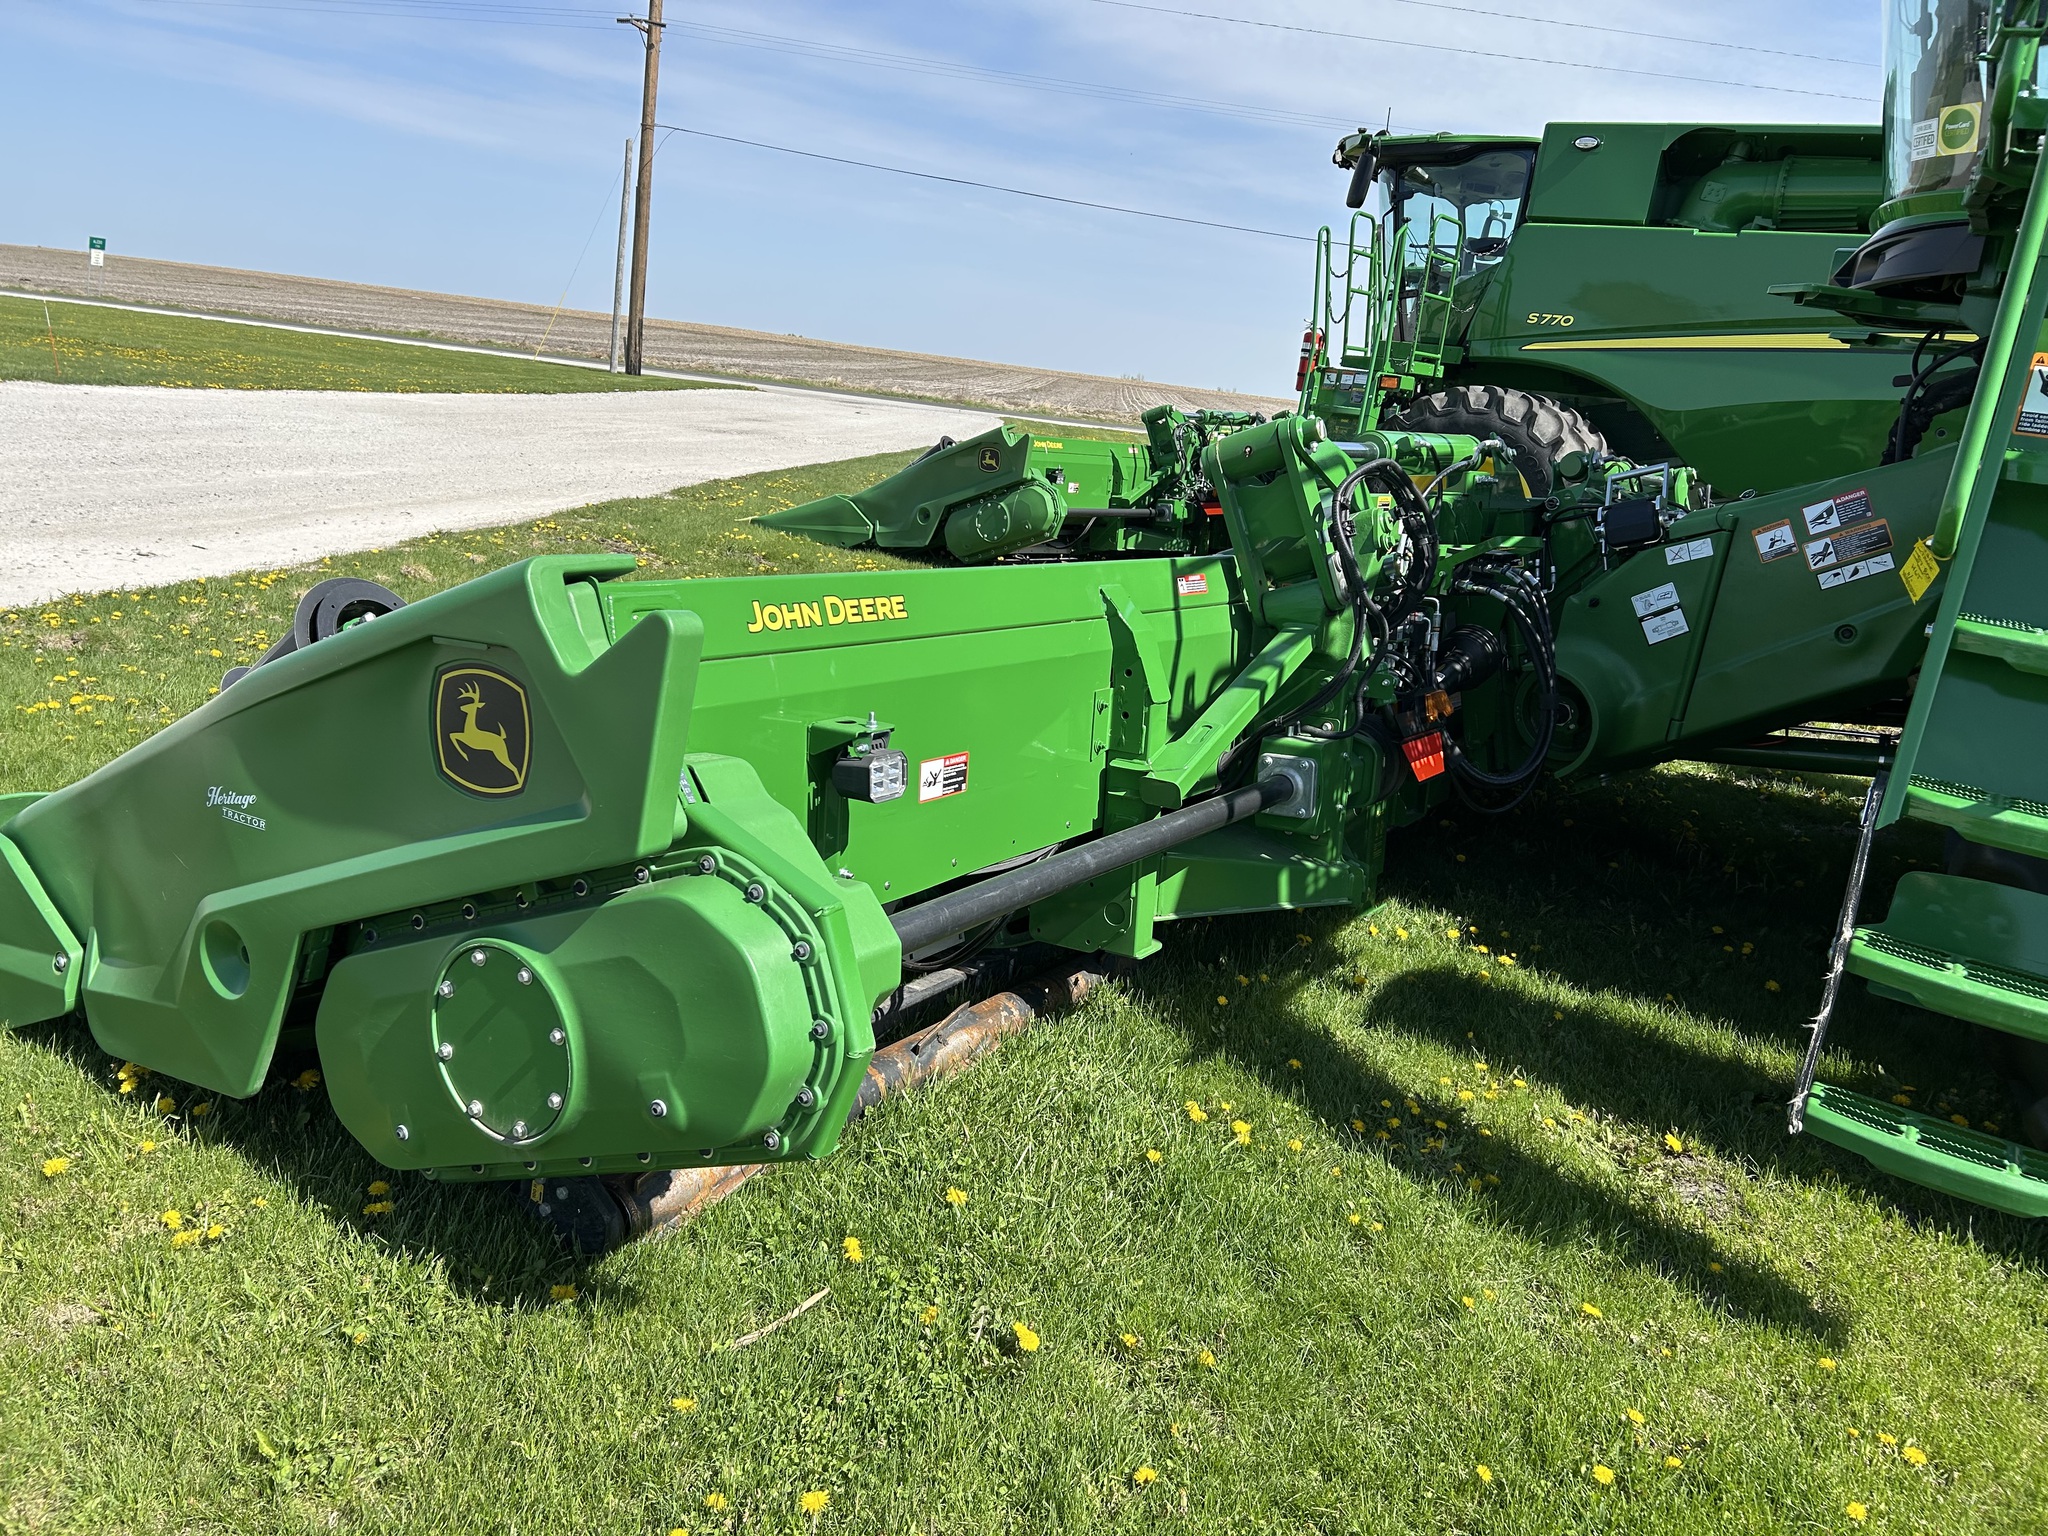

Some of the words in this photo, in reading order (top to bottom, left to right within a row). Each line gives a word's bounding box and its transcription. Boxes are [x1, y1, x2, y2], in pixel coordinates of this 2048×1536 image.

[1840, 490, 1866, 502] DANGER
[747, 599, 823, 633] JOHN
[823, 595, 908, 626] DEERE
[206, 786, 257, 810] Heritage
[222, 808, 266, 829] TRACTOR
